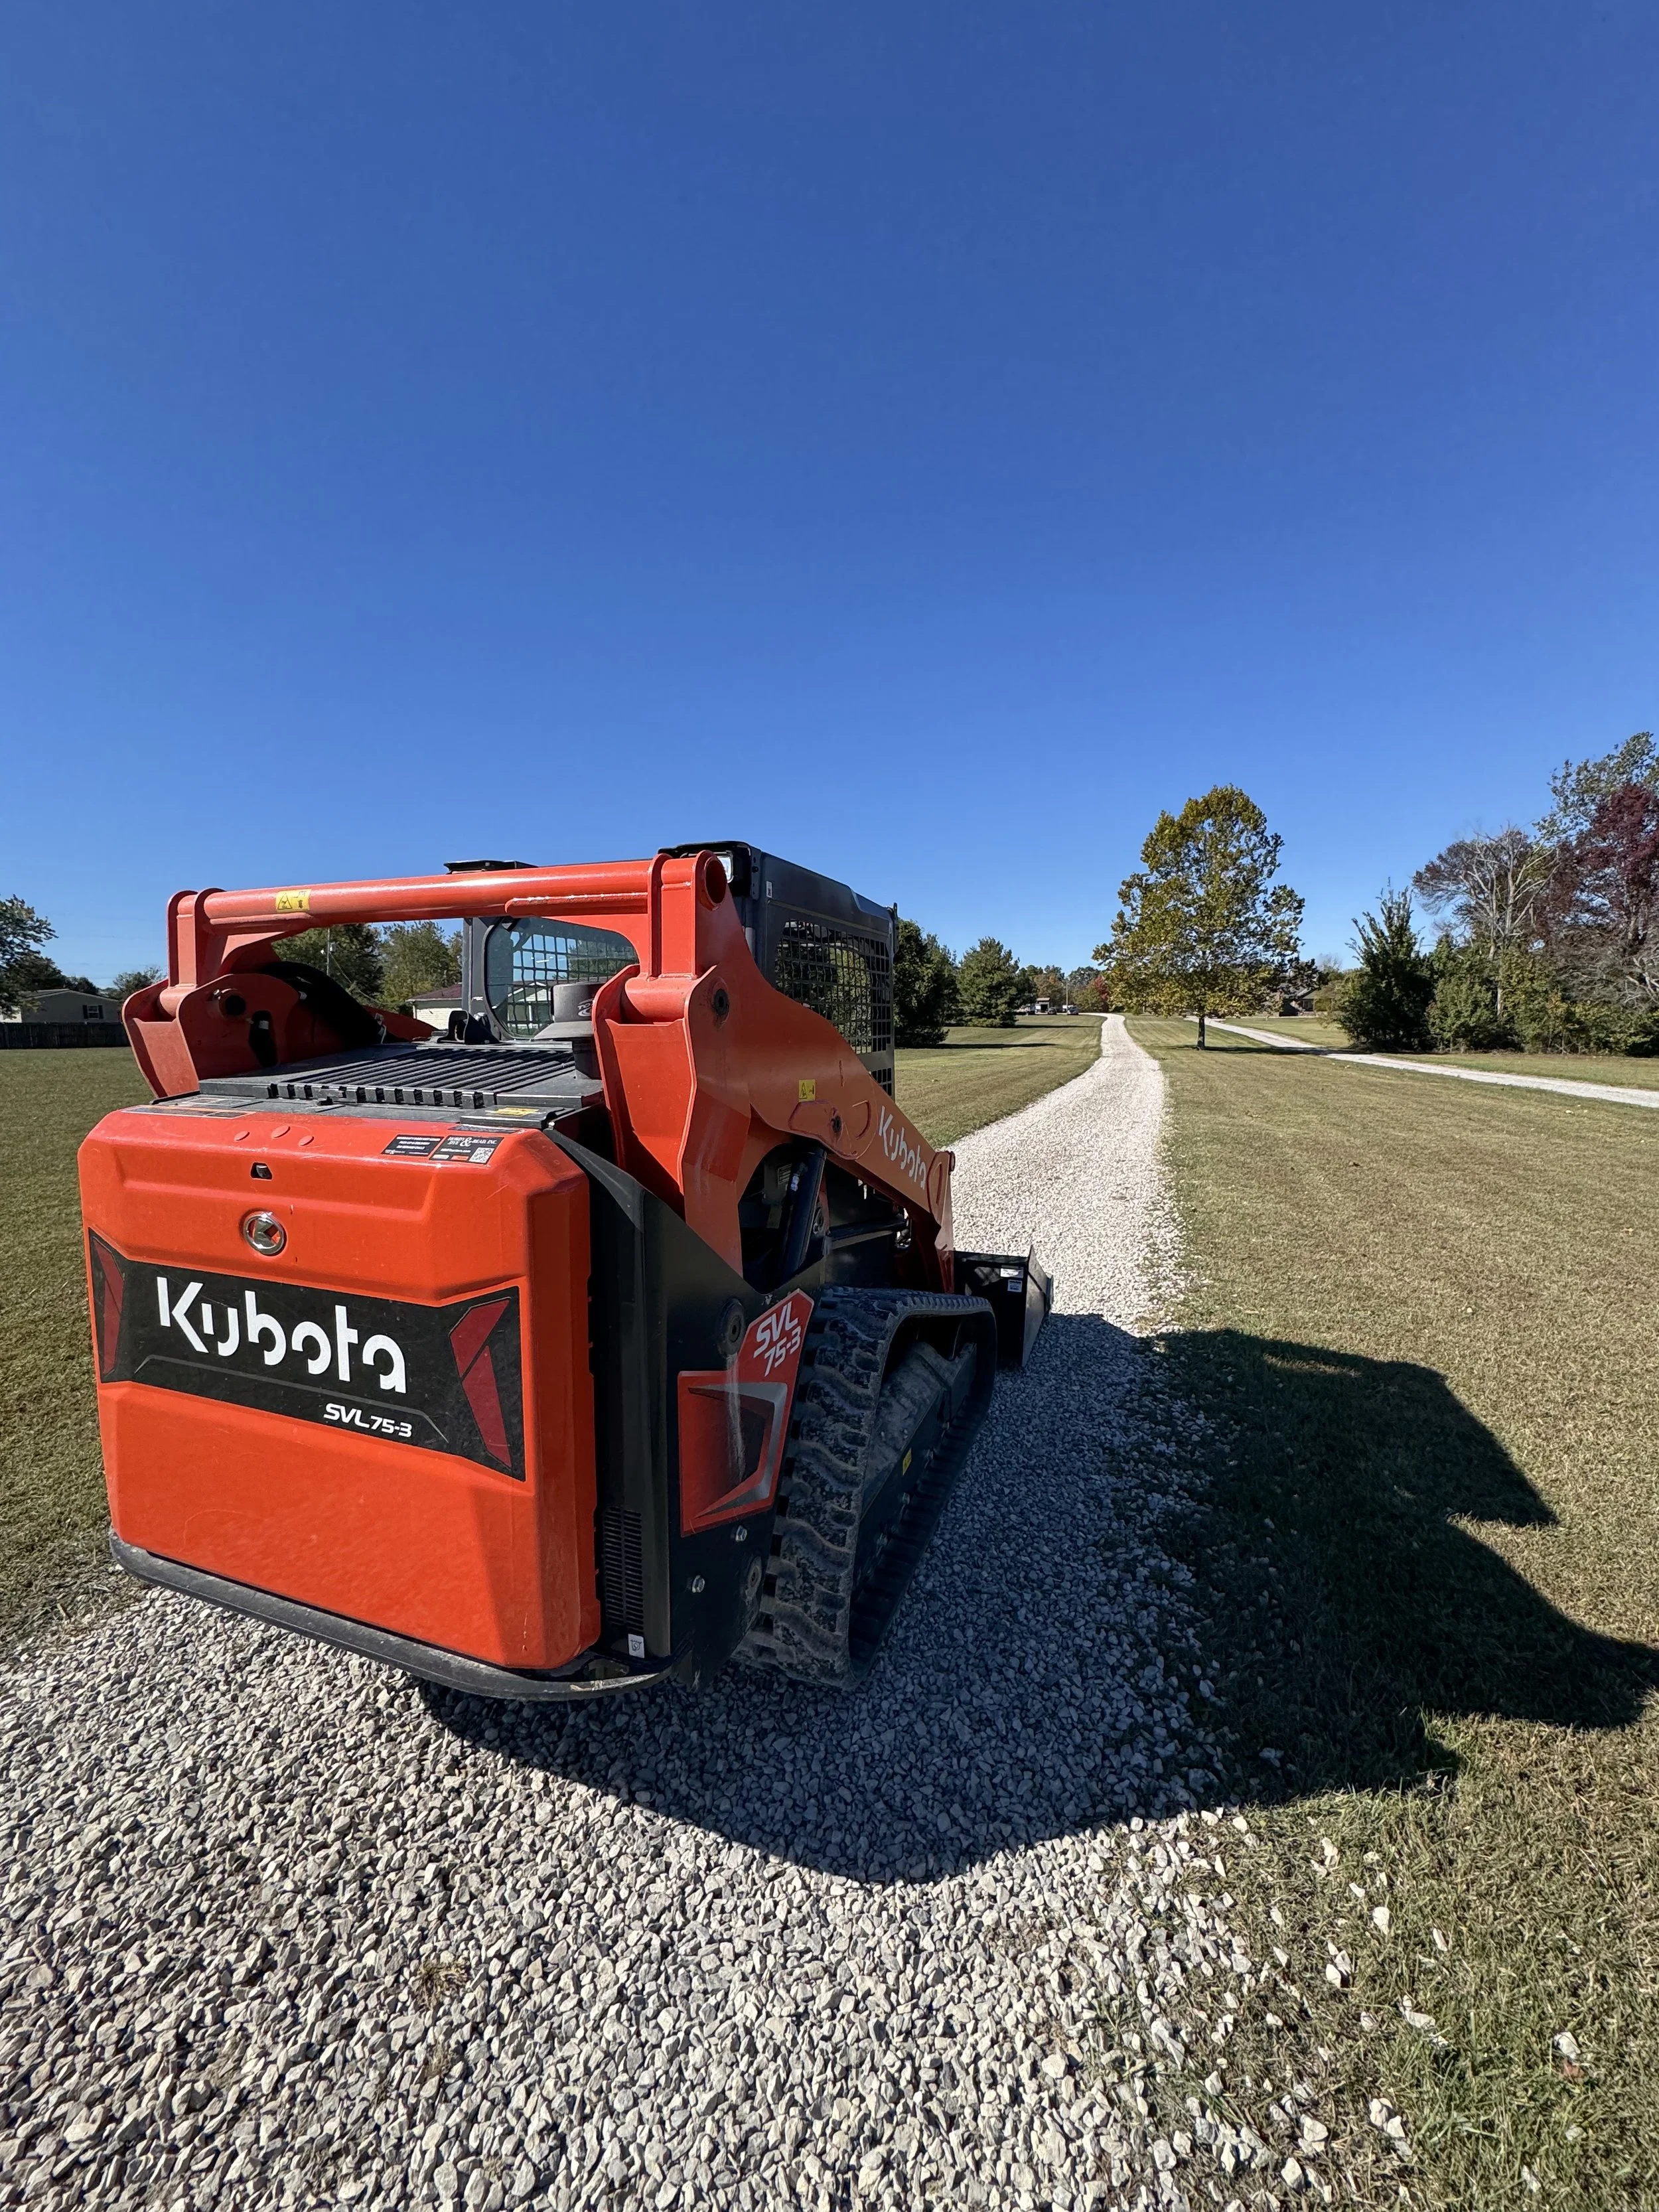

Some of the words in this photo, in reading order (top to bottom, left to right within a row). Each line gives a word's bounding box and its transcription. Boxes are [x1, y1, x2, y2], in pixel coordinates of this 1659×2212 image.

[879, 1105, 926, 1190] Kubota
[157, 1276, 406, 1394] Kubota
[753, 1301, 798, 1359] SVL
[764, 1326, 801, 1377] 75-3
